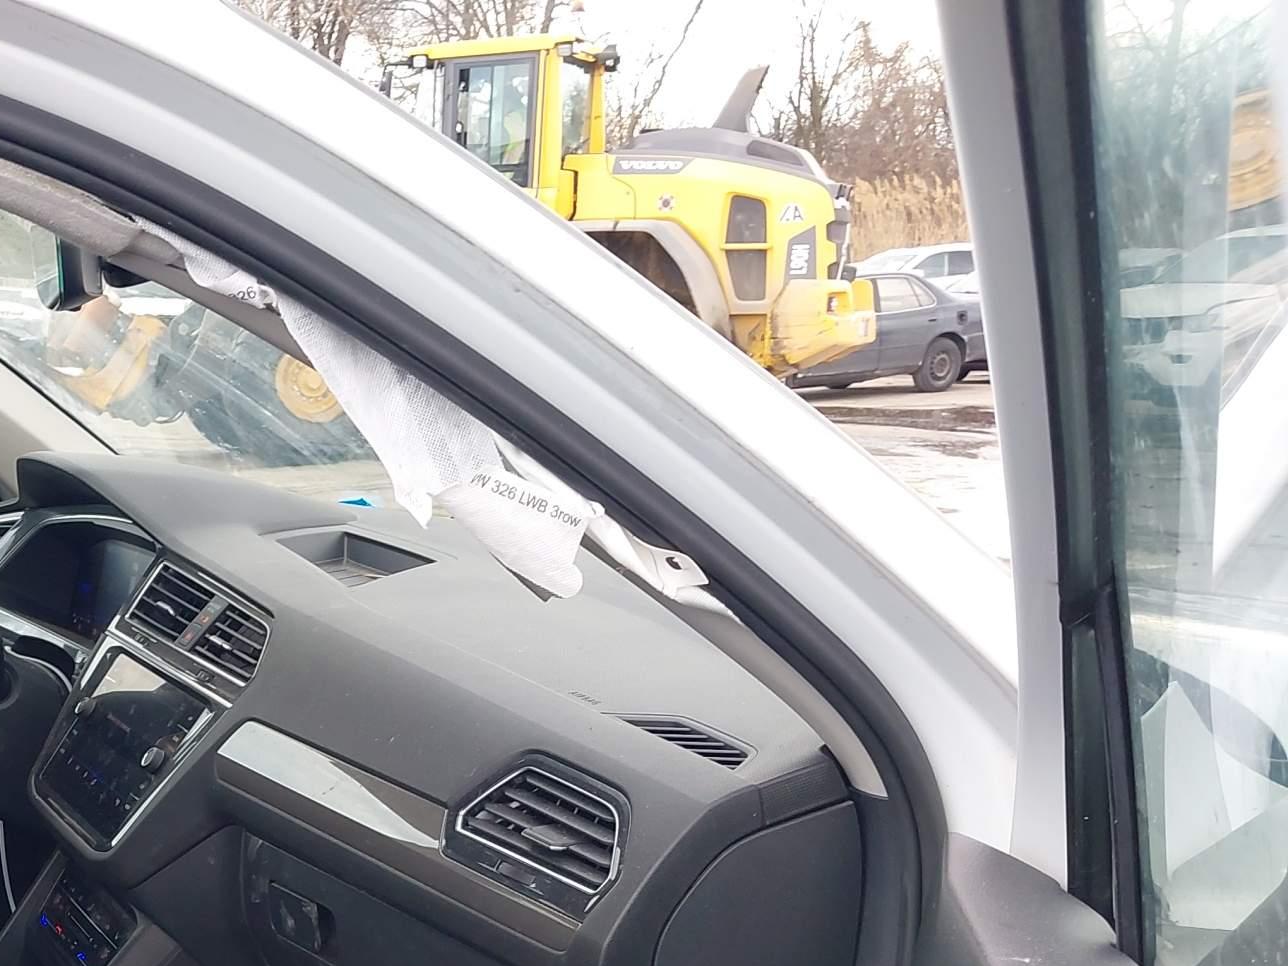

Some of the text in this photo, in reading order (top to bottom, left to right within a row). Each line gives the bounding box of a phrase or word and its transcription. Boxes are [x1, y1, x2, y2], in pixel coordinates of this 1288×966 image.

[618, 159, 684, 170] VOLVO
[491, 479, 518, 501] 326
[518, 491, 549, 514] LWB
[550, 504, 583, 528] 3row
